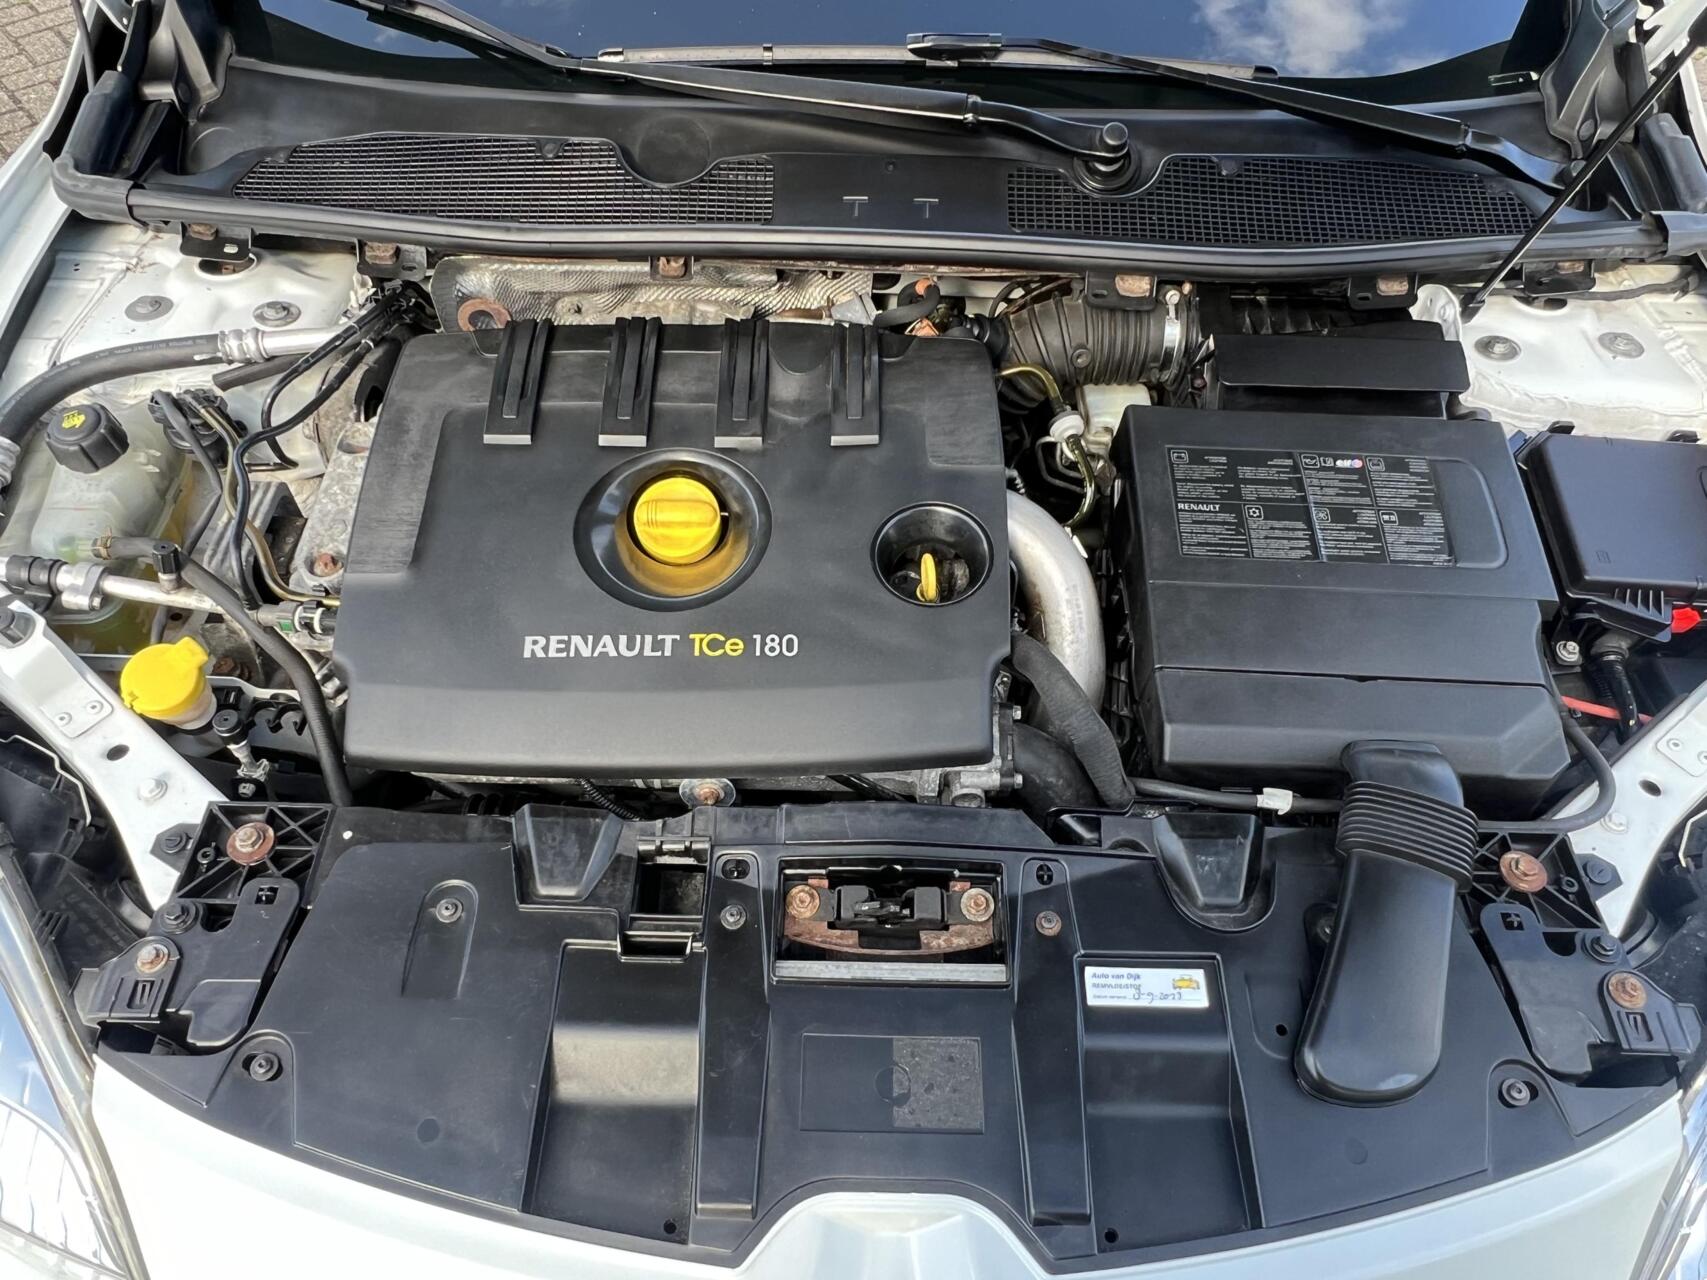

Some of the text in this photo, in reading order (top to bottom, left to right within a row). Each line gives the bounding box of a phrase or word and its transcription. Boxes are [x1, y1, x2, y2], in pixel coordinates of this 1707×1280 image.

[1177, 503, 1220, 512] RENAULT
[523, 633, 799, 658] RENAULT TCe 180
[1126, 972, 1141, 981] Dijk
